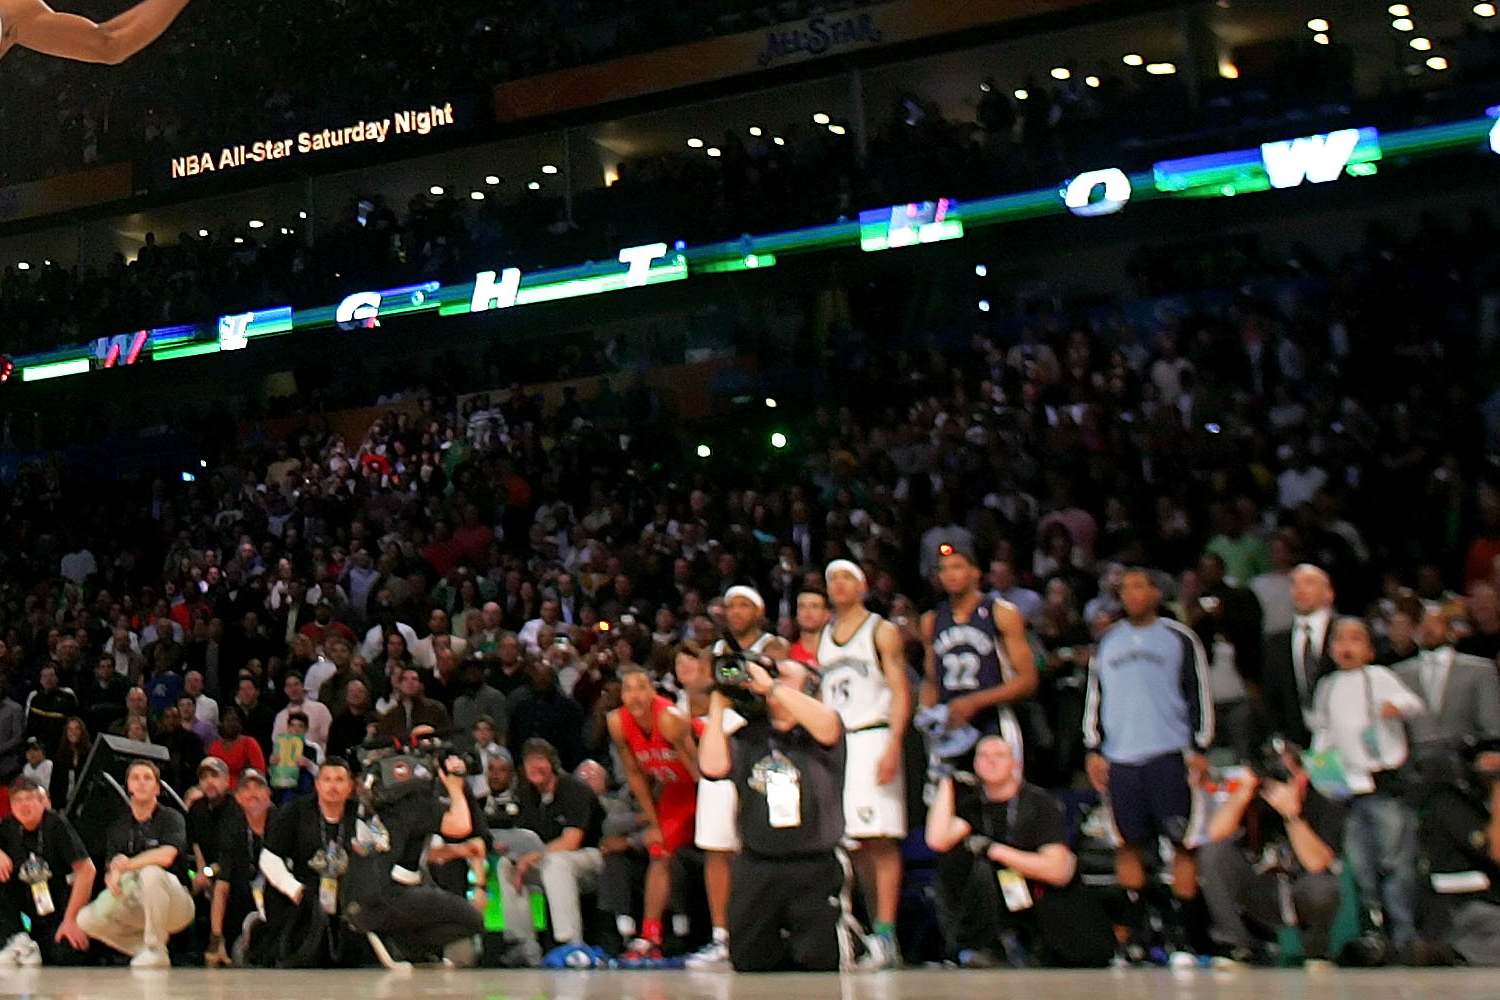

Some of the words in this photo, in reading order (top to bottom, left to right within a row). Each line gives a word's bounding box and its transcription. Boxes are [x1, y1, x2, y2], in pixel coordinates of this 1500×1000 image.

[171, 152, 215, 178] NBA
[219, 138, 293, 169] All-Star
[297, 118, 390, 153] Saturday
[394, 103, 454, 134] Night
[942, 651, 981, 691] 22
